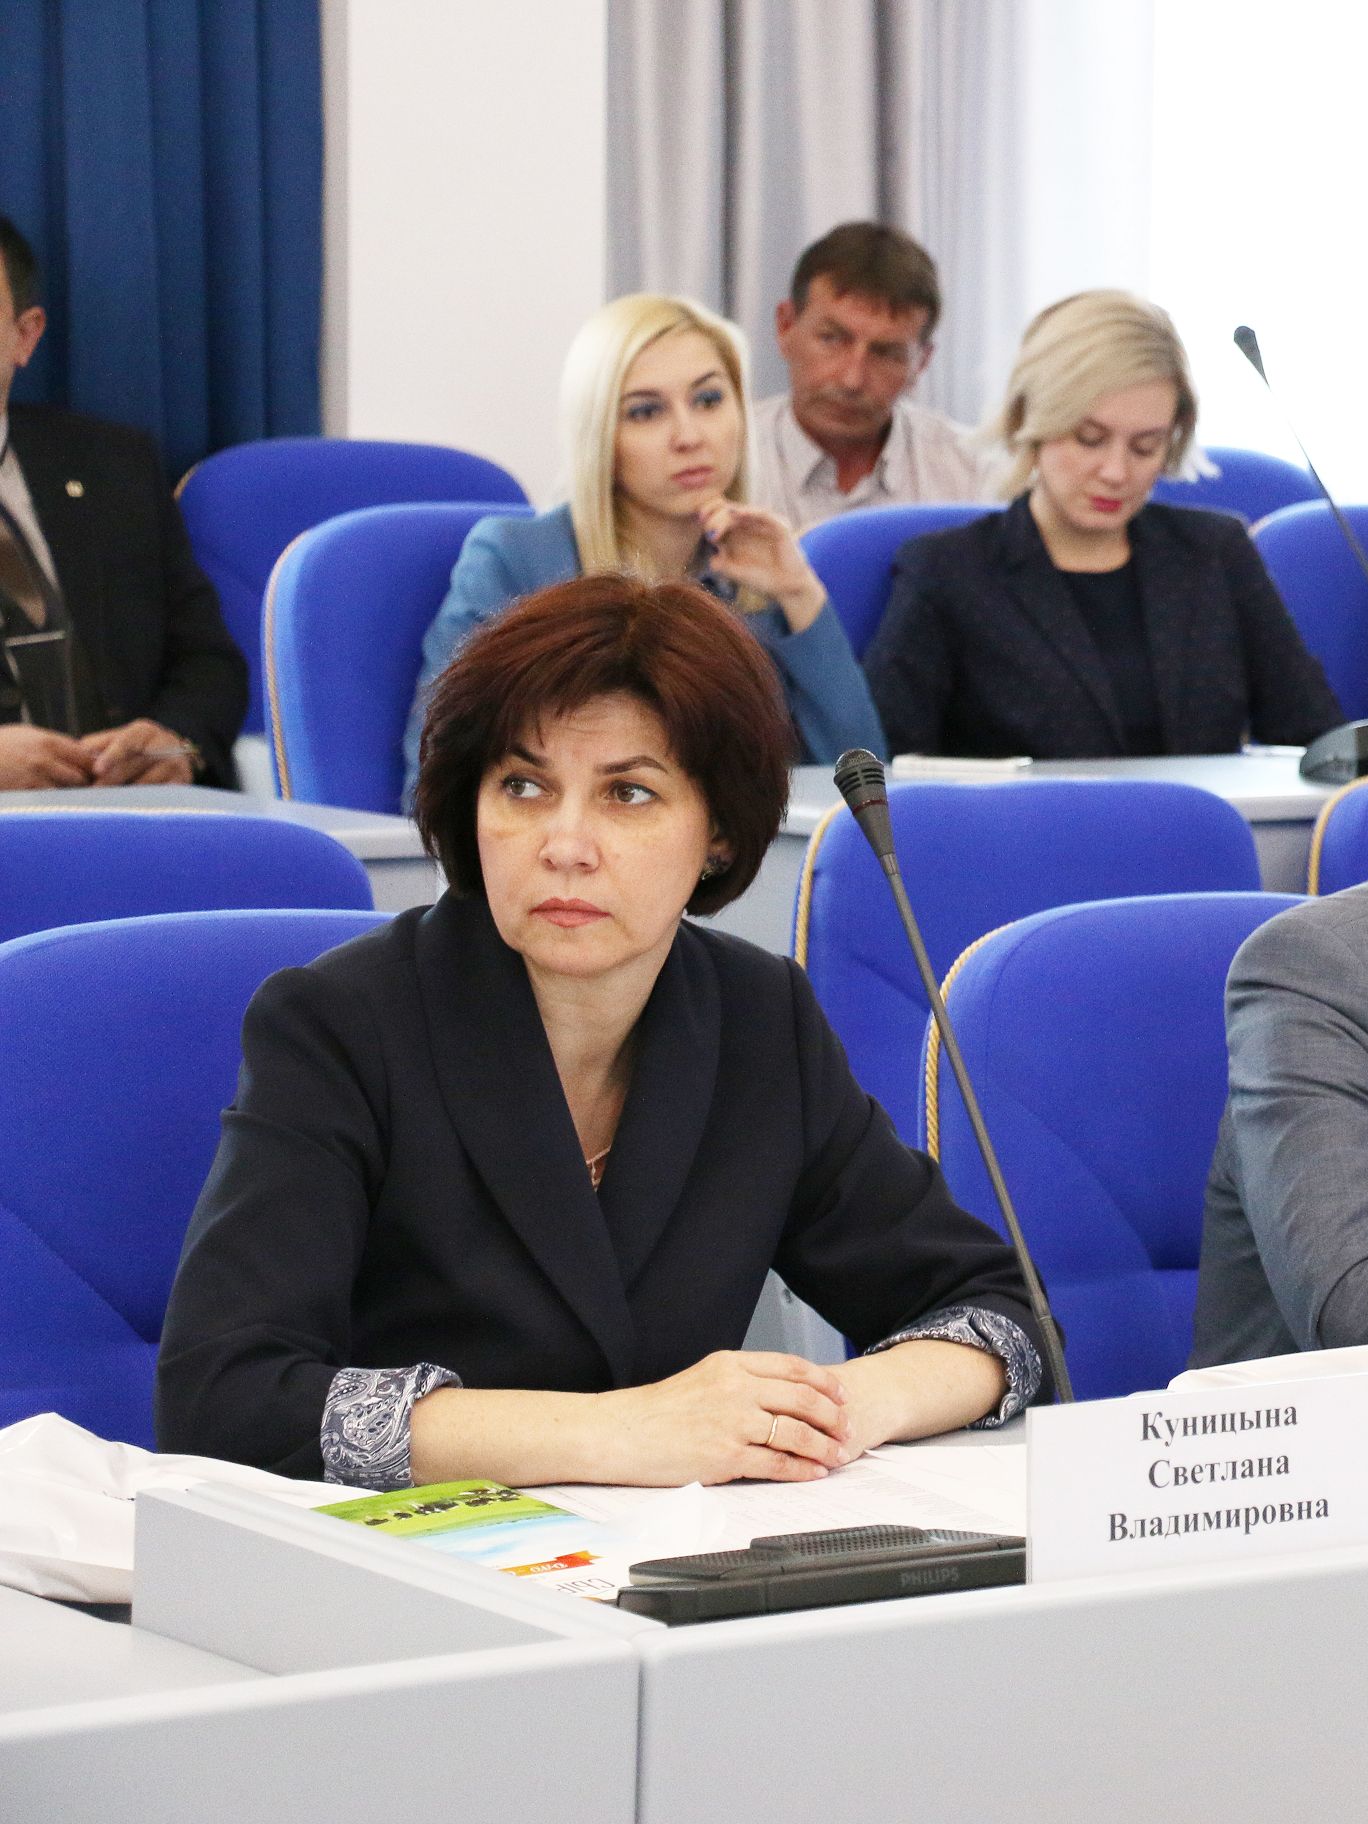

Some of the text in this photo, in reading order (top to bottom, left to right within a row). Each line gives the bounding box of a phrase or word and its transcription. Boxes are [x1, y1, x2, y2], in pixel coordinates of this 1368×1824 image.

[1141, 1405, 1298, 1447] Куницына
[1148, 1454, 1290, 1489] Светлана
[1108, 1497, 1330, 1542] Владимировна
[901, 1567, 960, 1587] PHILIPS
